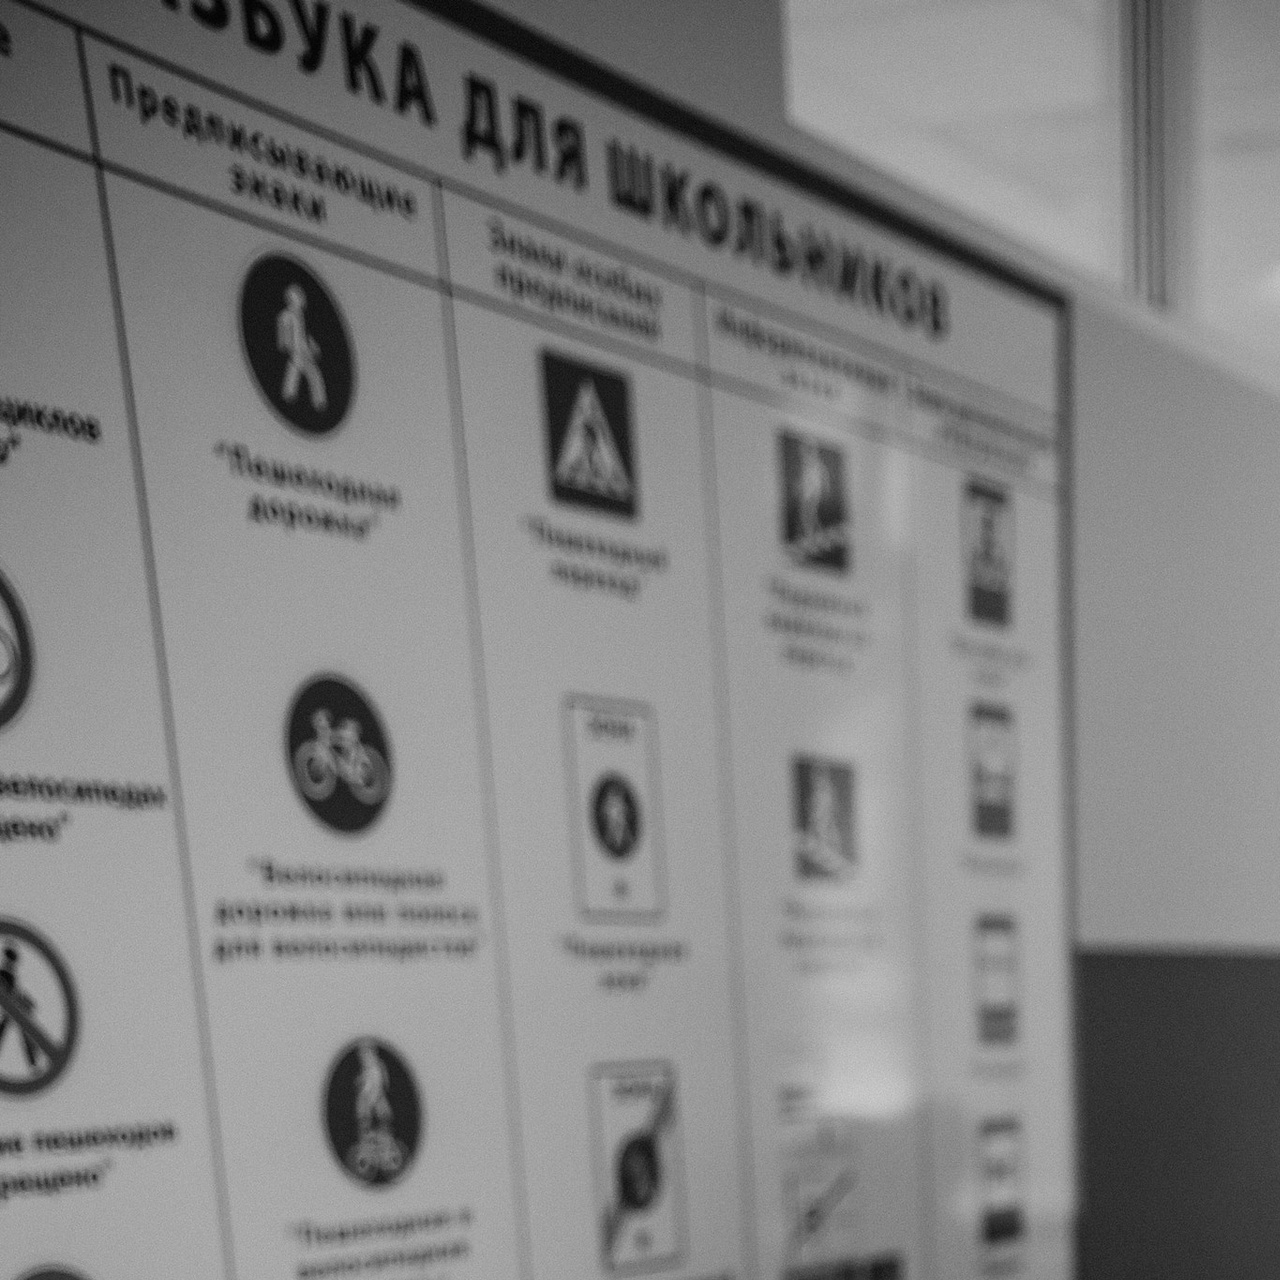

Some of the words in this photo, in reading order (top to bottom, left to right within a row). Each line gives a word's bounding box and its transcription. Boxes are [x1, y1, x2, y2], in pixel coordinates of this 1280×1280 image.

[108, 62, 418, 219] Предписывающие
[461, 70, 590, 193] ДЛЯ
[604, 137, 950, 344] ШКОЛЬНИКОВ
